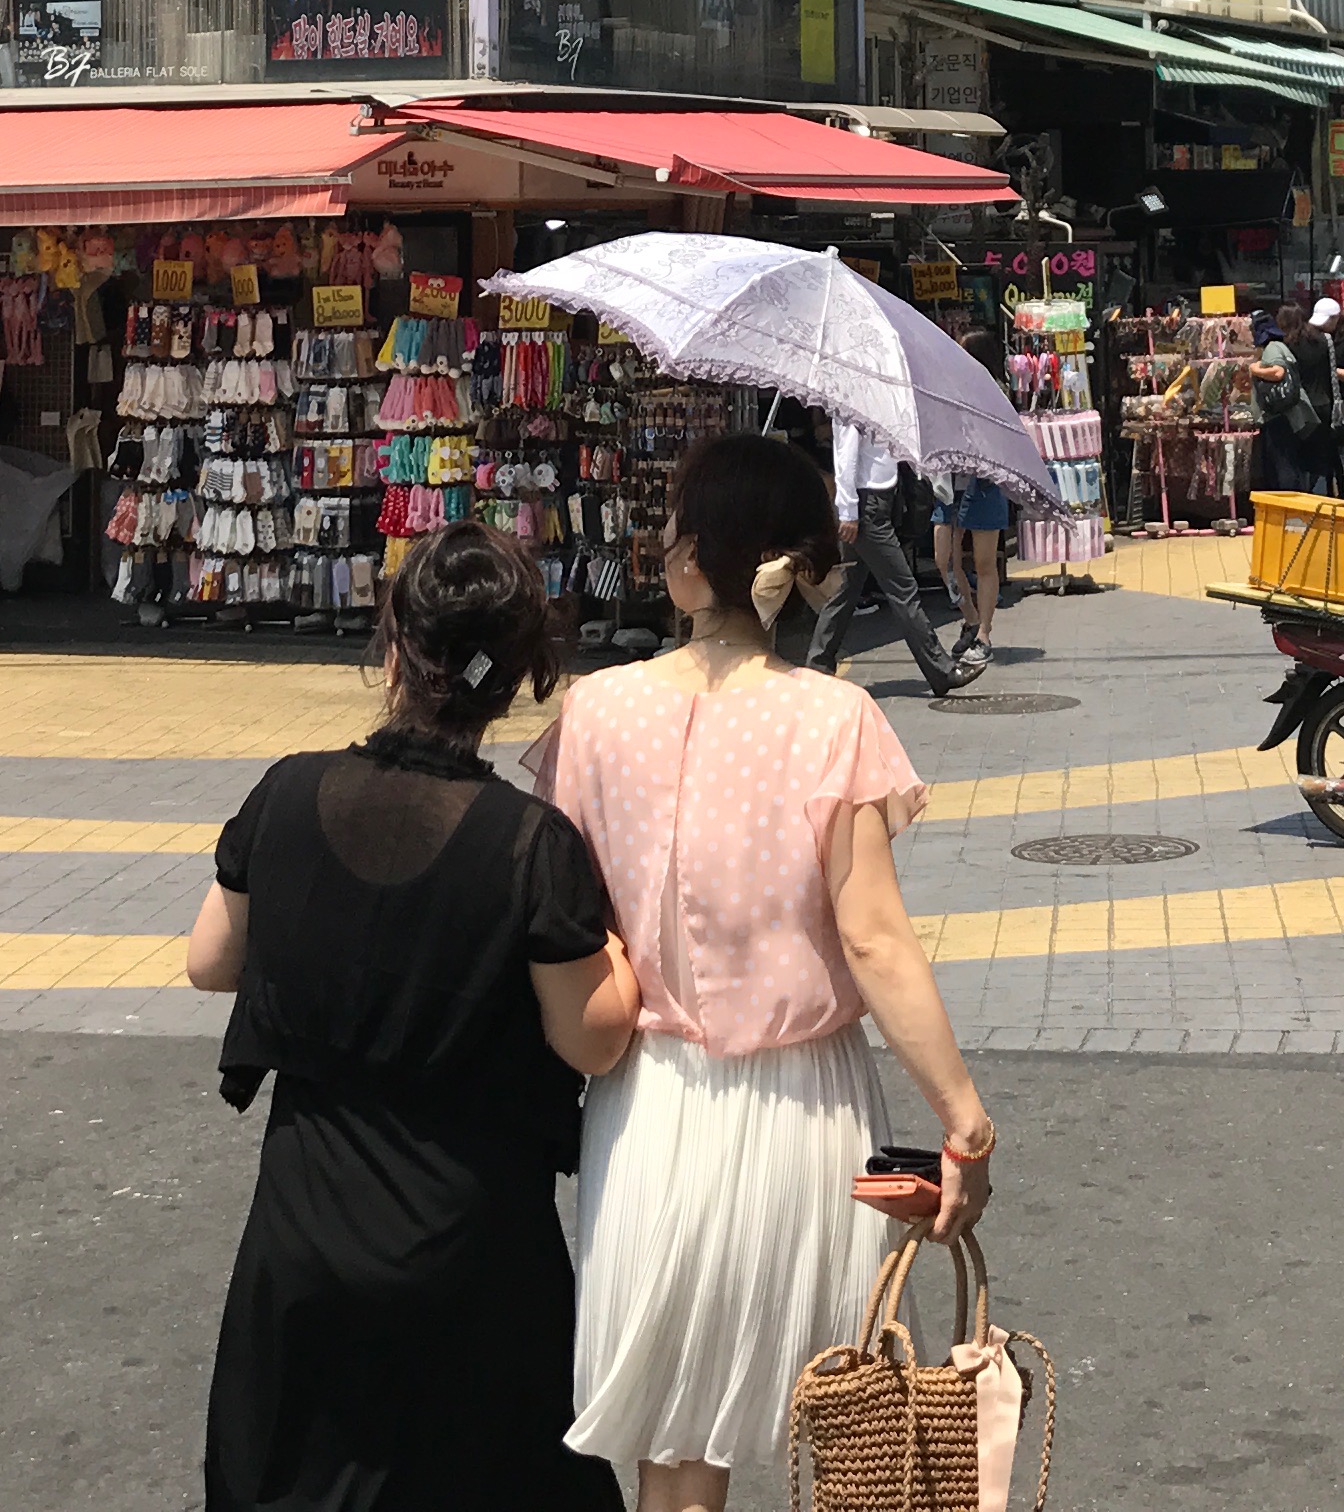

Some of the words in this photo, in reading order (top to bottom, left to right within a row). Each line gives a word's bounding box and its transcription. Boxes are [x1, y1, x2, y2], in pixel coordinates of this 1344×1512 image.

[292, 12, 324, 60] 많이
[89, 66, 141, 80] BALLERIA
[145, 65, 176, 79] FLAT
[179, 65, 209, 78] SOLE
[931, 86, 978, 105] 기업인
